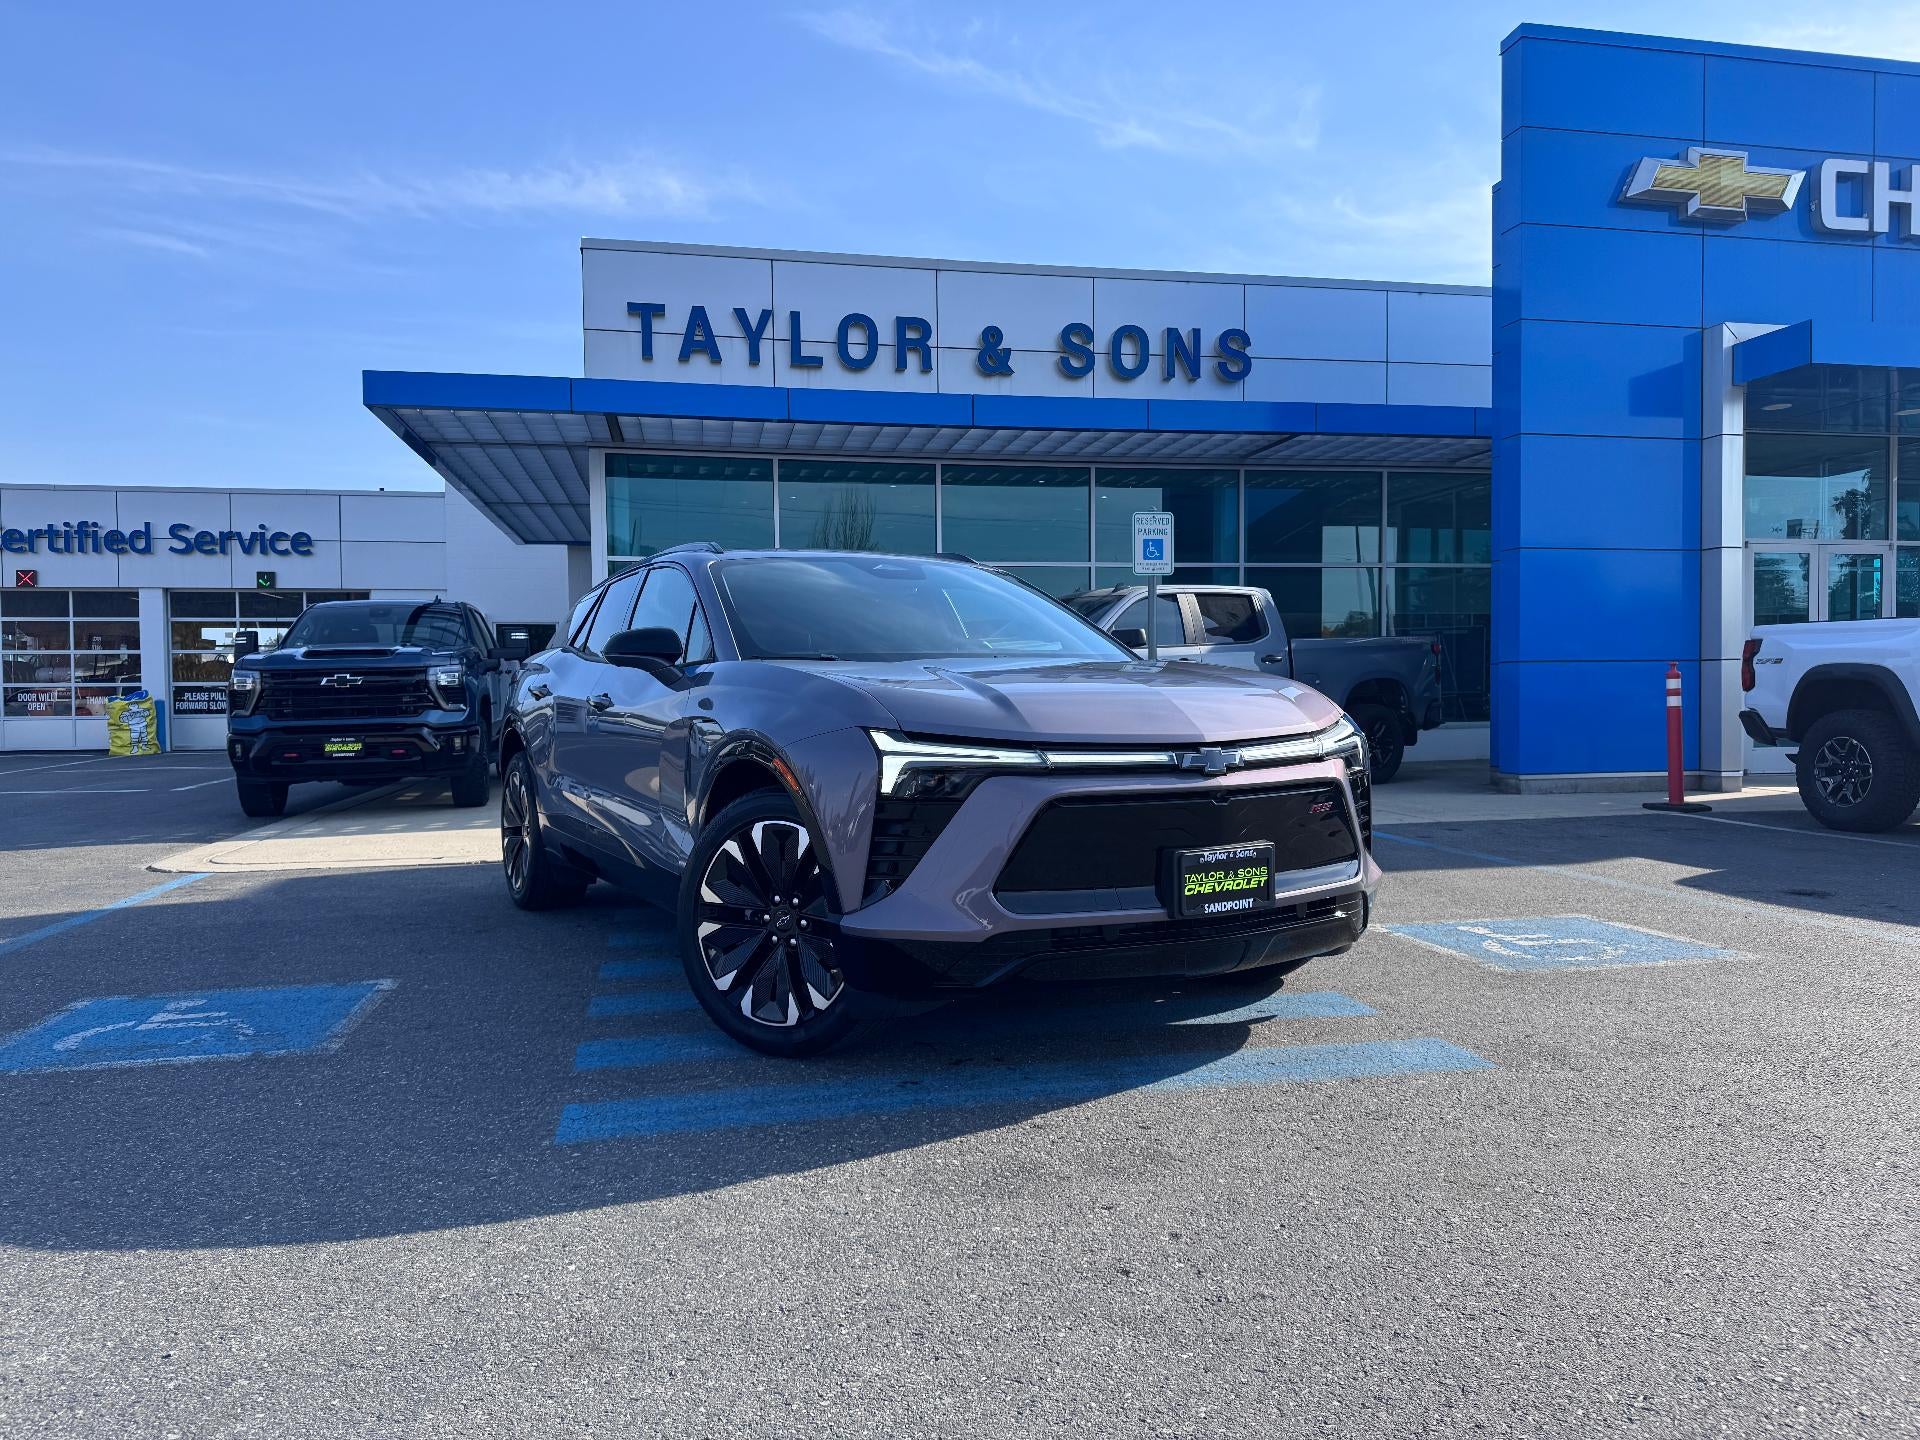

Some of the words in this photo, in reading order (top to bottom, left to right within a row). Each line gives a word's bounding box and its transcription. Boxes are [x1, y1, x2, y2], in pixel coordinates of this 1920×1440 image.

[1820, 158, 1920, 236] CH
[627, 302, 933, 373] TAYLOR
[976, 325, 1015, 377] &
[1056, 322, 1252, 382] SONS
[1136, 517, 1170, 525] RESERVED
[168, 523, 313, 556] Service
[17, 693, 37, 702] DOOR
[38, 693, 55, 702] WILL
[184, 692, 209, 701] PLEASE
[210, 692, 227, 701] PULL
[27, 702, 46, 711] OPEN
[175, 701, 208, 710] FORWARD
[1204, 852, 1228, 863] Taylor
[1236, 849, 1254, 858] Sons
[1184, 871, 1225, 883] TAYLOR
[1227, 870, 1235, 880] &
[1237, 866, 1268, 877] SONS
[1184, 877, 1268, 896] CHEVROLET
[1204, 898, 1254, 914] SANDPOINT
